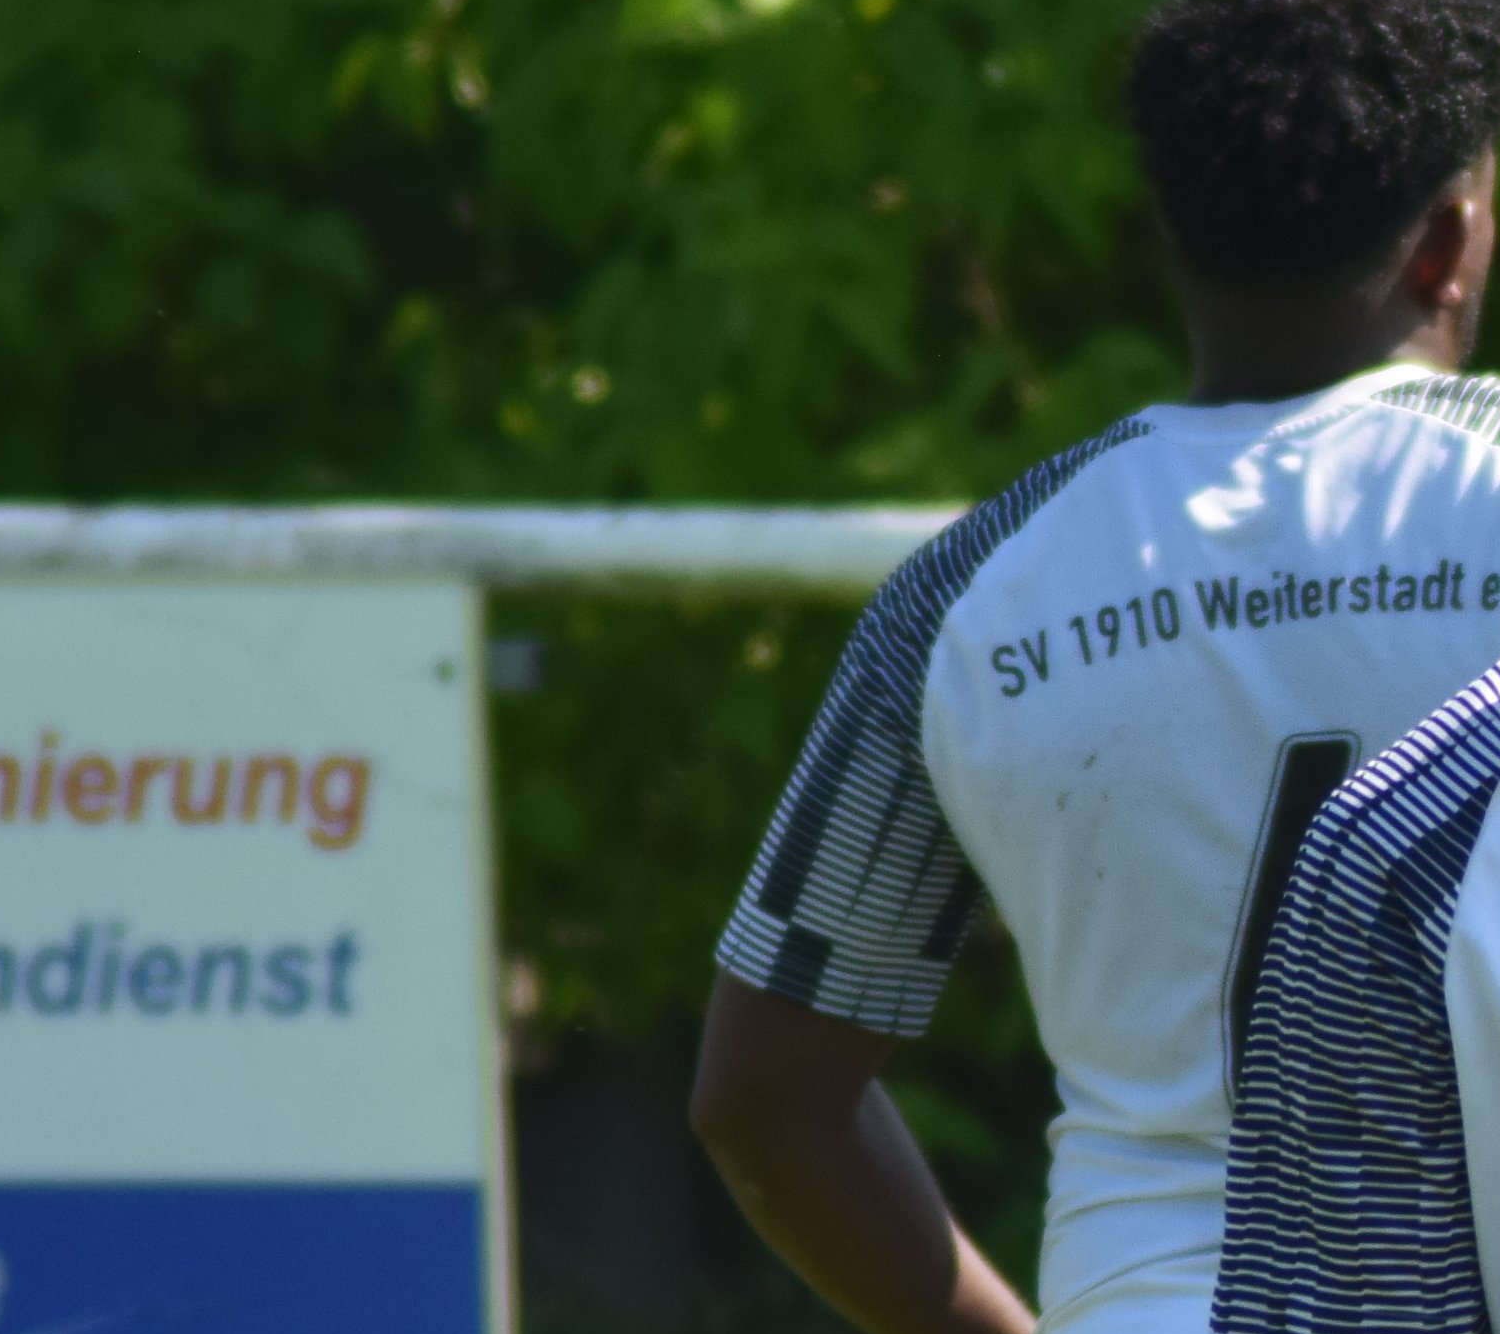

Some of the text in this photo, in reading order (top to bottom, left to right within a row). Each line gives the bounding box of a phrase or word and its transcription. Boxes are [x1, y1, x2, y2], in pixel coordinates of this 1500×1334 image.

[991, 629, 1051, 697] SV
[1069, 589, 1180, 666] 1910
[1195, 559, 1464, 631] Weiterstadt
